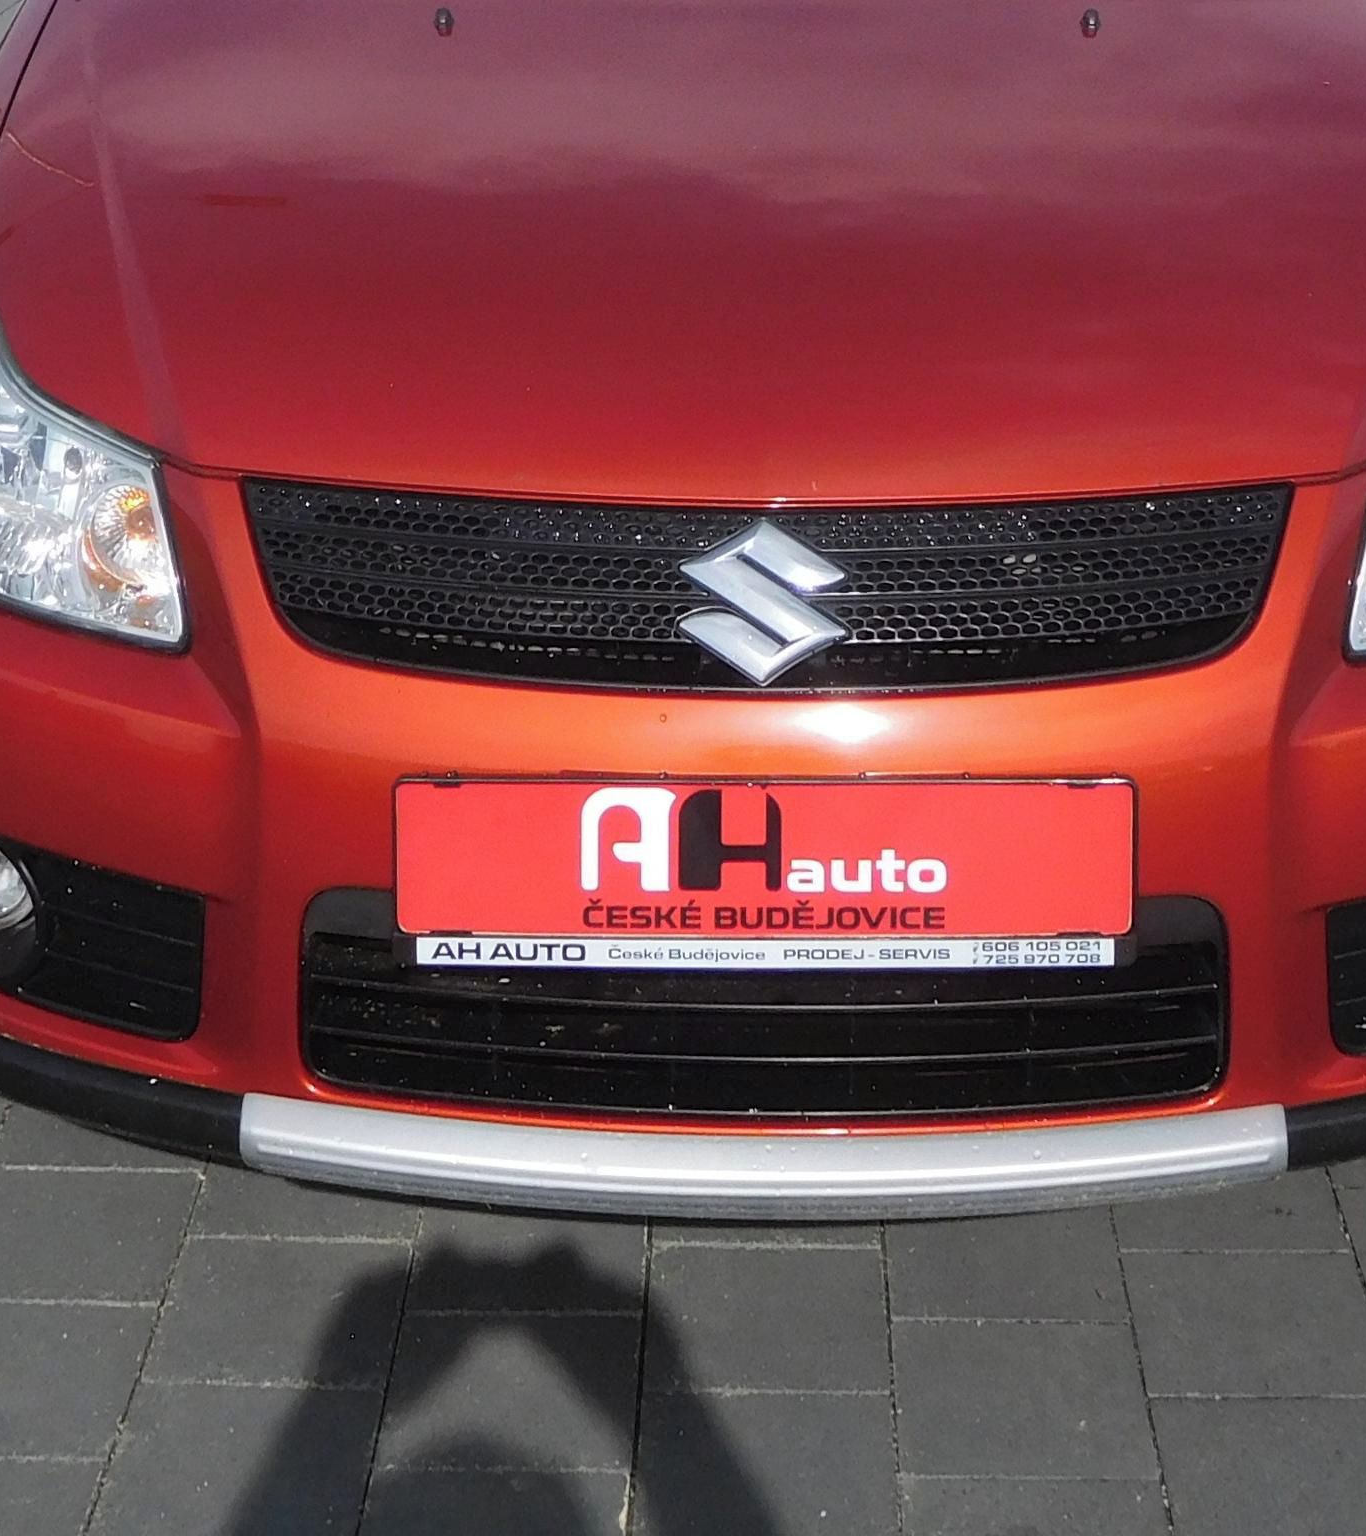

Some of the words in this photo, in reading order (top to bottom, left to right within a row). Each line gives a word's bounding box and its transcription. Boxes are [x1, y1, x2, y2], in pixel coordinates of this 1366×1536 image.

[583, 898, 702, 930] ČESKÉ
[714, 900, 946, 930] BUDĚJOVICE
[431, 942, 482, 960] AH
[489, 943, 586, 962] AUTO
[608, 944, 664, 960] České
[668, 948, 766, 963] Budějovice
[982, 941, 1020, 952] 606
[1025, 941, 1061, 951] 105
[1065, 940, 1101, 951] 021
[878, 948, 951, 960] SERVIS
[982, 954, 1019, 965] 725
[1024, 954, 1060, 964] 970
[1064, 953, 1101, 964] 708
